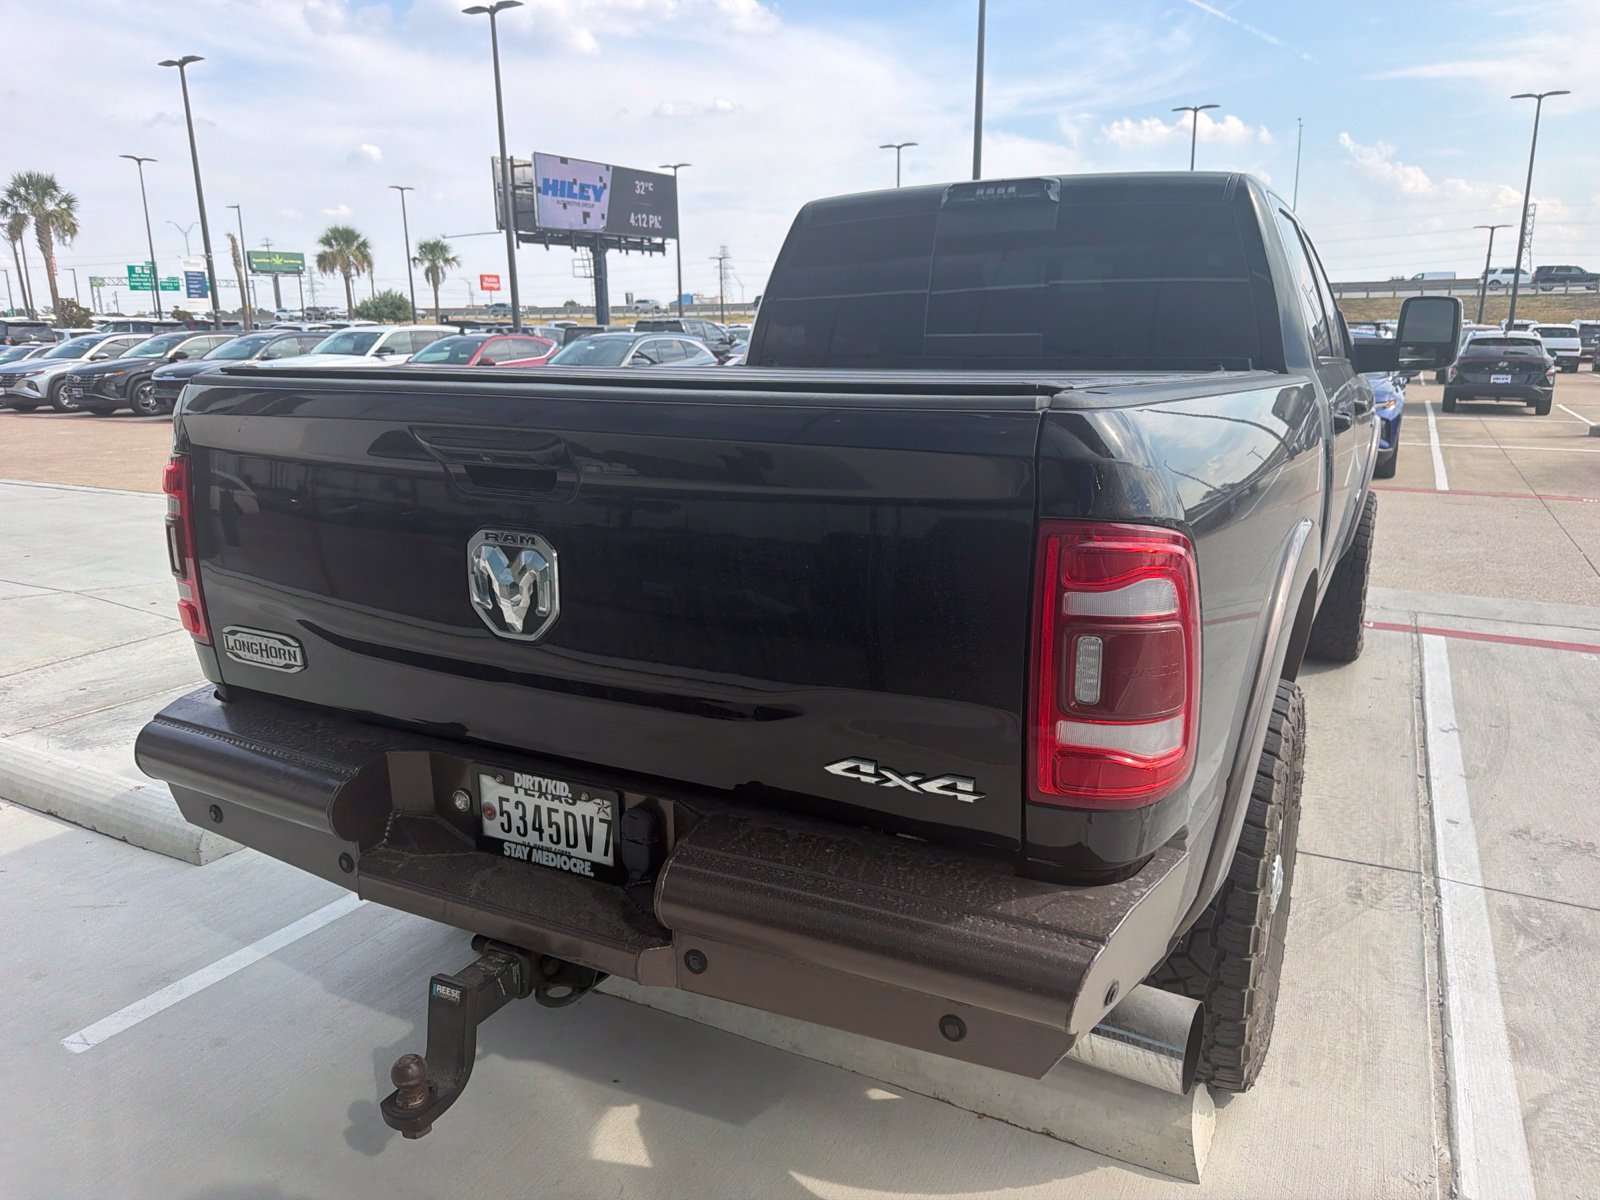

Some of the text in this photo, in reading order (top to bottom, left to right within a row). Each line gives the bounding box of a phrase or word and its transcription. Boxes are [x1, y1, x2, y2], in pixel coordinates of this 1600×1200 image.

[542, 177, 606, 203] HILEY
[629, 212, 648, 228] 4:12
[484, 532, 536, 546] RAM
[223, 635, 299, 663] LONGHORN
[497, 795, 613, 858] 5345DV7
[503, 841, 532, 862] STAY
[436, 984, 461, 999] REESE
